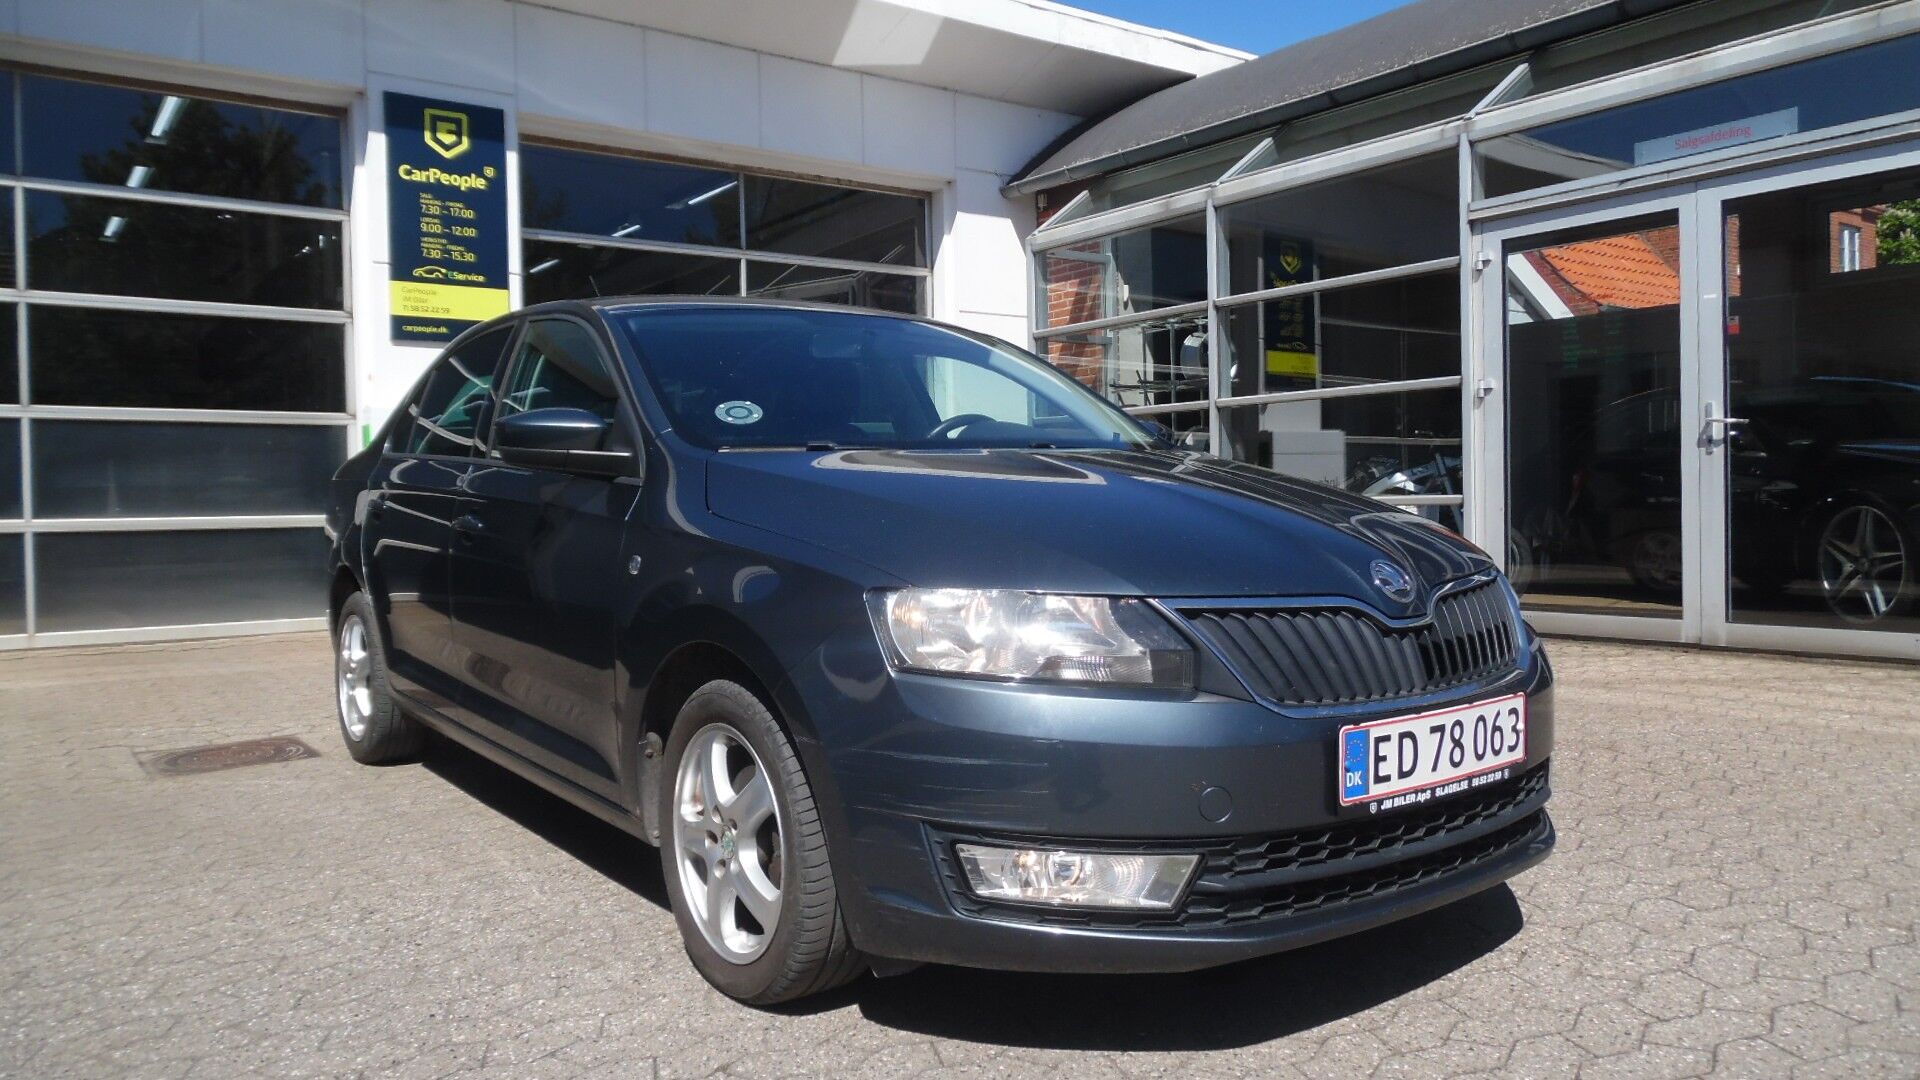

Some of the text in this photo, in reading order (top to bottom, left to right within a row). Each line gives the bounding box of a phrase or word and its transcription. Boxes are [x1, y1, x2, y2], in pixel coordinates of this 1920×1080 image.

[1675, 126, 1753, 150] Salgsafdeling
[398, 164, 487, 191] CarPeople
[421, 205, 440, 215] 7.30
[450, 208, 474, 218] 17.00
[420, 222, 442, 233] 9.00
[451, 226, 476, 236] 12.00
[421, 248, 441, 258] 7.30
[450, 251, 474, 261] 15.30
[401, 286, 437, 296] CarPeople
[402, 324, 449, 334] carpeople.dk
[1373, 707, 1520, 784] ED 78 063
[1346, 771, 1362, 787] DK
[1381, 798, 1393, 810] JM
[1394, 793, 1416, 807] BILER
[1417, 790, 1431, 804] ApS
[1435, 780, 1469, 797] SLAGELSE
